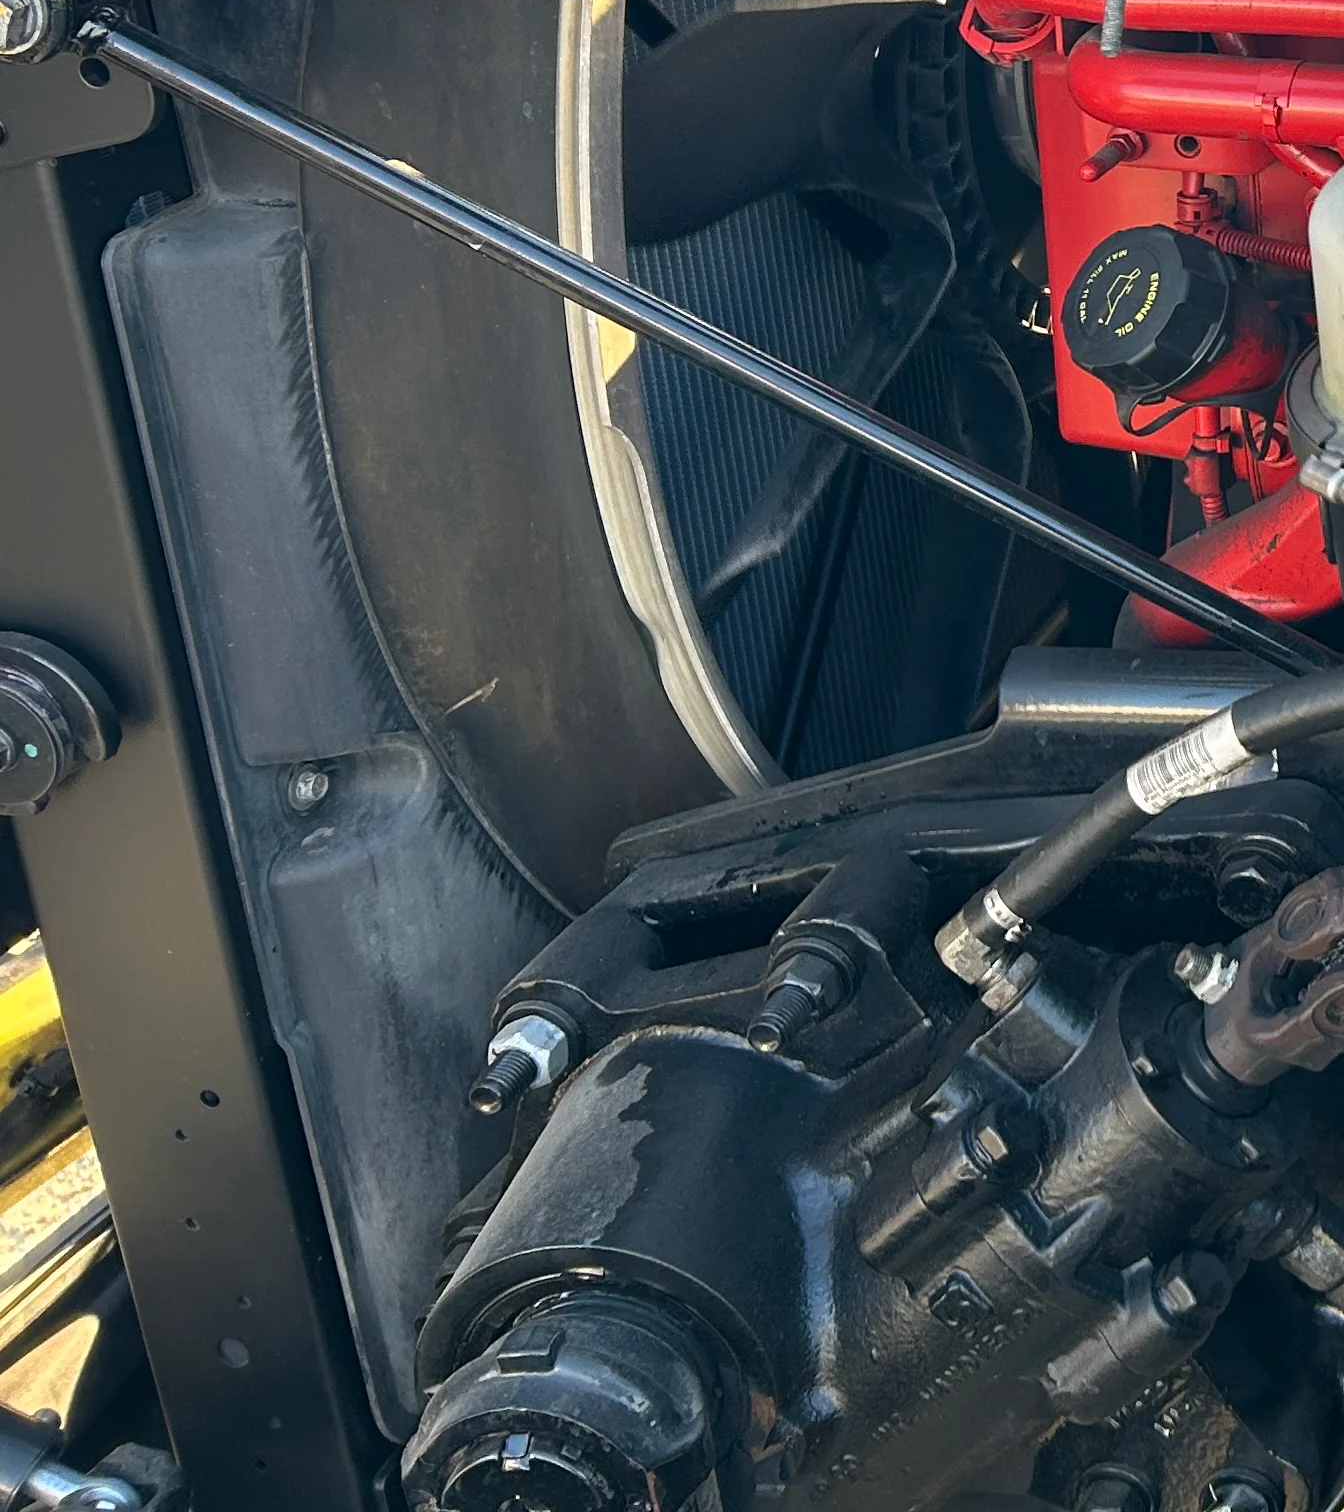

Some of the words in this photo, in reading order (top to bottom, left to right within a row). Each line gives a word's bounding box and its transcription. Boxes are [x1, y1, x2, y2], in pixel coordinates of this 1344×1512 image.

[1105, 249, 1128, 265] MAX
[1086, 264, 1104, 285] FILL
[1134, 272, 1160, 323] ENGINE
[1079, 301, 1088, 324] GAL
[1114, 322, 1134, 337] OIL
